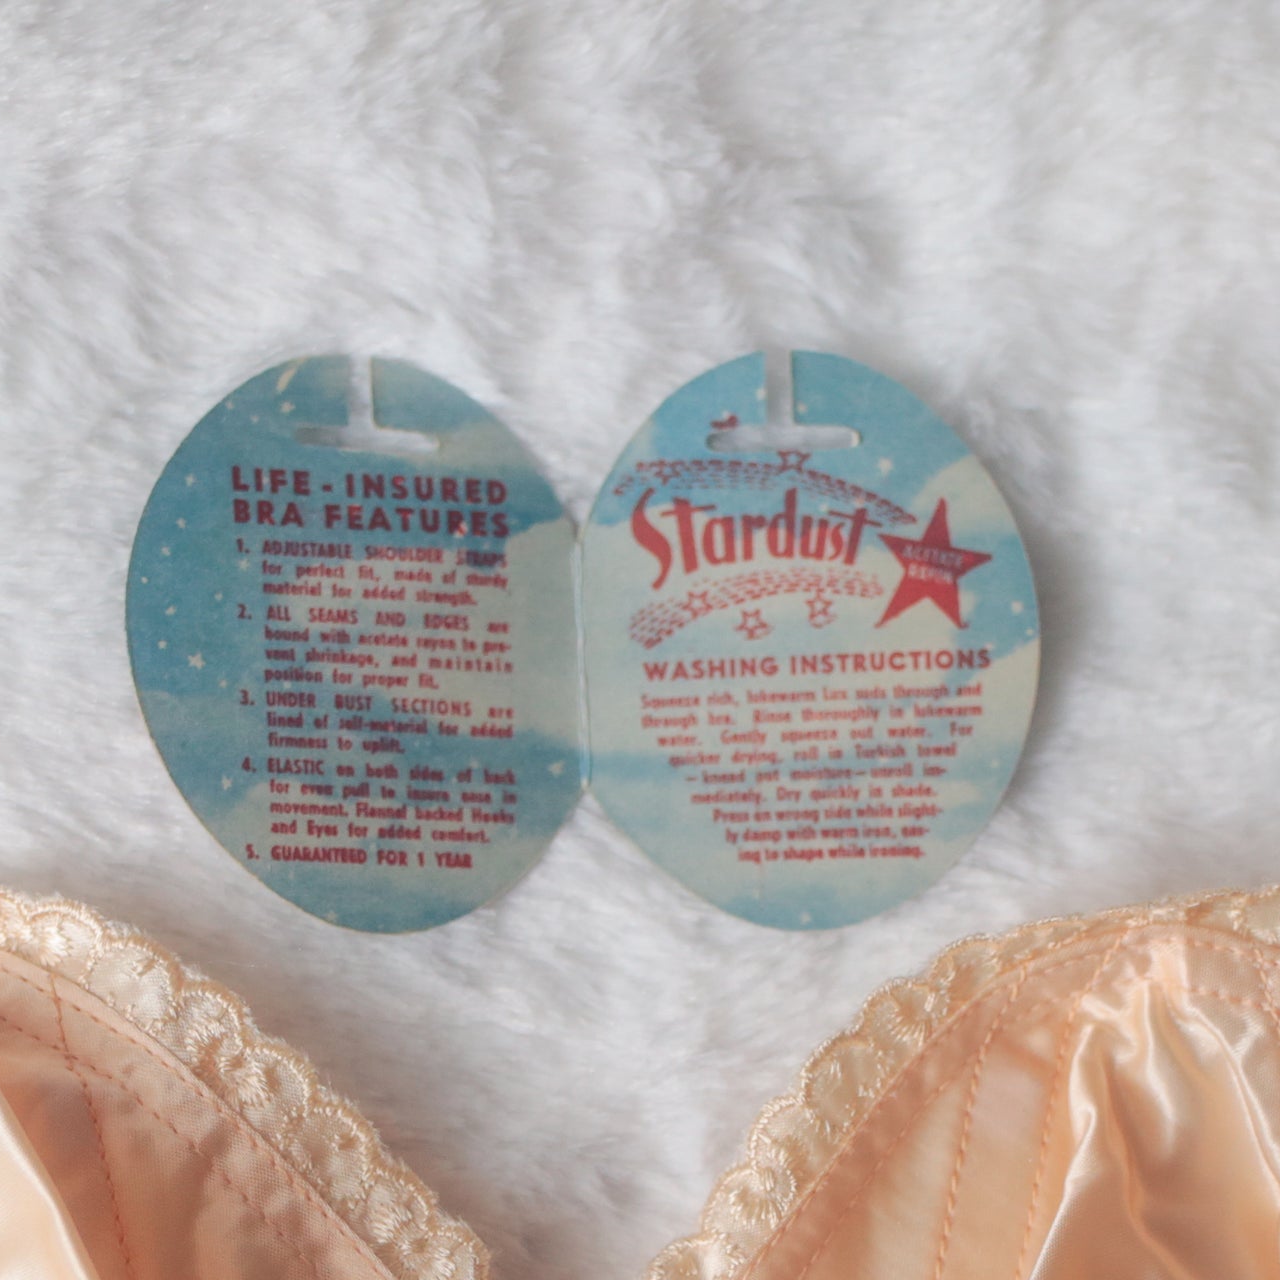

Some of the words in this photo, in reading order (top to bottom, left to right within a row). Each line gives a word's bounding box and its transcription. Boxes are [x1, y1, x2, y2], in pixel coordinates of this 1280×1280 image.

[232, 465, 310, 495] LIFE
[346, 474, 507, 505] INSURED
[233, 499, 304, 527] BRA
[325, 505, 510, 538] FEATURES
[236, 538, 250, 553] 1.
[263, 540, 352, 559] ADJUSTABLE
[365, 545, 443, 563] SHOULDER
[631, 487, 882, 590] Stardust
[262, 560, 282, 575] for
[296, 563, 344, 579] perfect
[358, 565, 380, 581] fit,
[394, 569, 432, 583] made
[443, 569, 455, 584] of
[466, 574, 507, 589] sturdy
[263, 582, 321, 596] material
[332, 584, 352, 598] for
[362, 587, 405, 599] added
[238, 604, 251, 620] 2.
[267, 606, 290, 621] ALL
[309, 608, 358, 625] SEAMS
[376, 611, 406, 626] AND
[423, 613, 469, 631] EDGES
[487, 623, 509, 633] are
[265, 626, 309, 641] bound
[320, 629, 350, 643] with
[358, 632, 408, 647] acetate
[416, 636, 455, 651] rayon
[462, 635, 476, 649] to
[482, 640, 511, 653] pre-
[265, 650, 295, 662] vent
[305, 651, 379, 667] shrinkage,
[392, 654, 416, 667] and
[429, 657, 513, 673] maintain
[643, 657, 779, 681] WASHING
[790, 649, 992, 675] INSTRUCTIONS
[264, 669, 323, 683] position
[332, 669, 353, 683] for
[362, 675, 408, 688] proper
[418, 675, 438, 689] fit.
[240, 690, 255, 706] 3.
[266, 692, 316, 708] UNDER
[334, 694, 372, 711] BUST
[392, 698, 472, 716] SECTIONS
[488, 707, 513, 718] are
[640, 693, 700, 710] Squeeze
[747, 689, 815, 705] lukewarm
[856, 686, 886, 699] suds
[893, 684, 949, 701] through
[957, 683, 982, 697] and
[267, 713, 303, 727] lined
[314, 715, 328, 729] of
[339, 717, 428, 734] self-material
[439, 721, 459, 736] for
[470, 725, 513, 738] added
[641, 714, 698, 730] through
[708, 712, 735, 727] bra.
[753, 708, 792, 724] Rinse
[802, 708, 880, 723] thoroughly
[889, 706, 904, 719] in
[913, 703, 983, 718] lukewarm
[268, 733, 327, 749] firmness
[338, 737, 352, 751] to
[362, 738, 405, 753] uplift.
[658, 733, 701, 747] water.
[721, 730, 767, 746] Gently
[781, 728, 838, 743] squeeze
[850, 726, 873, 740] out
[887, 724, 932, 739] water.
[950, 723, 973, 737] For
[669, 751, 722, 768] quicker
[794, 747, 818, 761] roll
[828, 746, 843, 759] in
[855, 744, 906, 759] Turkish
[917, 742, 957, 757] towel
[242, 757, 256, 773] 4.
[267, 758, 324, 775] ELASTIC
[337, 766, 355, 776] on
[366, 764, 398, 779] both
[409, 766, 444, 780] sides
[457, 768, 472, 782] of
[484, 769, 515, 784] back
[270, 780, 289, 794] for
[301, 784, 333, 795] even
[343, 783, 369, 798] pull
[381, 786, 395, 799] to
[407, 786, 449, 801] insure
[461, 792, 491, 803] ease
[502, 790, 517, 803] in
[690, 791, 766, 804] mediately.
[776, 788, 801, 802] Dry
[810, 786, 860, 802] quickly
[869, 785, 882, 799] in
[891, 784, 937, 799] shade.
[270, 802, 348, 817] movement.
[356, 803, 407, 819] Flannel
[415, 807, 462, 821] backed
[472, 809, 514, 824] Hooks
[713, 809, 749, 823] Press
[755, 809, 772, 822] on
[775, 808, 819, 822] wrong
[824, 806, 851, 820] side
[857, 804, 893, 818] while
[898, 803, 943, 819] slight-
[271, 821, 296, 834] and
[308, 821, 338, 838] Eyes
[348, 823, 368, 837] for
[378, 826, 421, 839] added
[431, 828, 490, 843] comfort.
[725, 828, 739, 844] ly
[743, 828, 782, 843] damp
[787, 826, 817, 841] with
[821, 826, 858, 840] warm
[863, 824, 896, 839] iron,
[246, 845, 259, 859] 5.
[271, 846, 367, 864] GUARANTEED
[377, 850, 407, 865] FOR
[417, 853, 424, 866] 1
[435, 853, 473, 868] YEAR
[738, 849, 761, 863] ing
[765, 848, 780, 861] to
[783, 846, 823, 861] shape
[828, 843, 865, 859] while
[871, 842, 925, 859] ironing.
